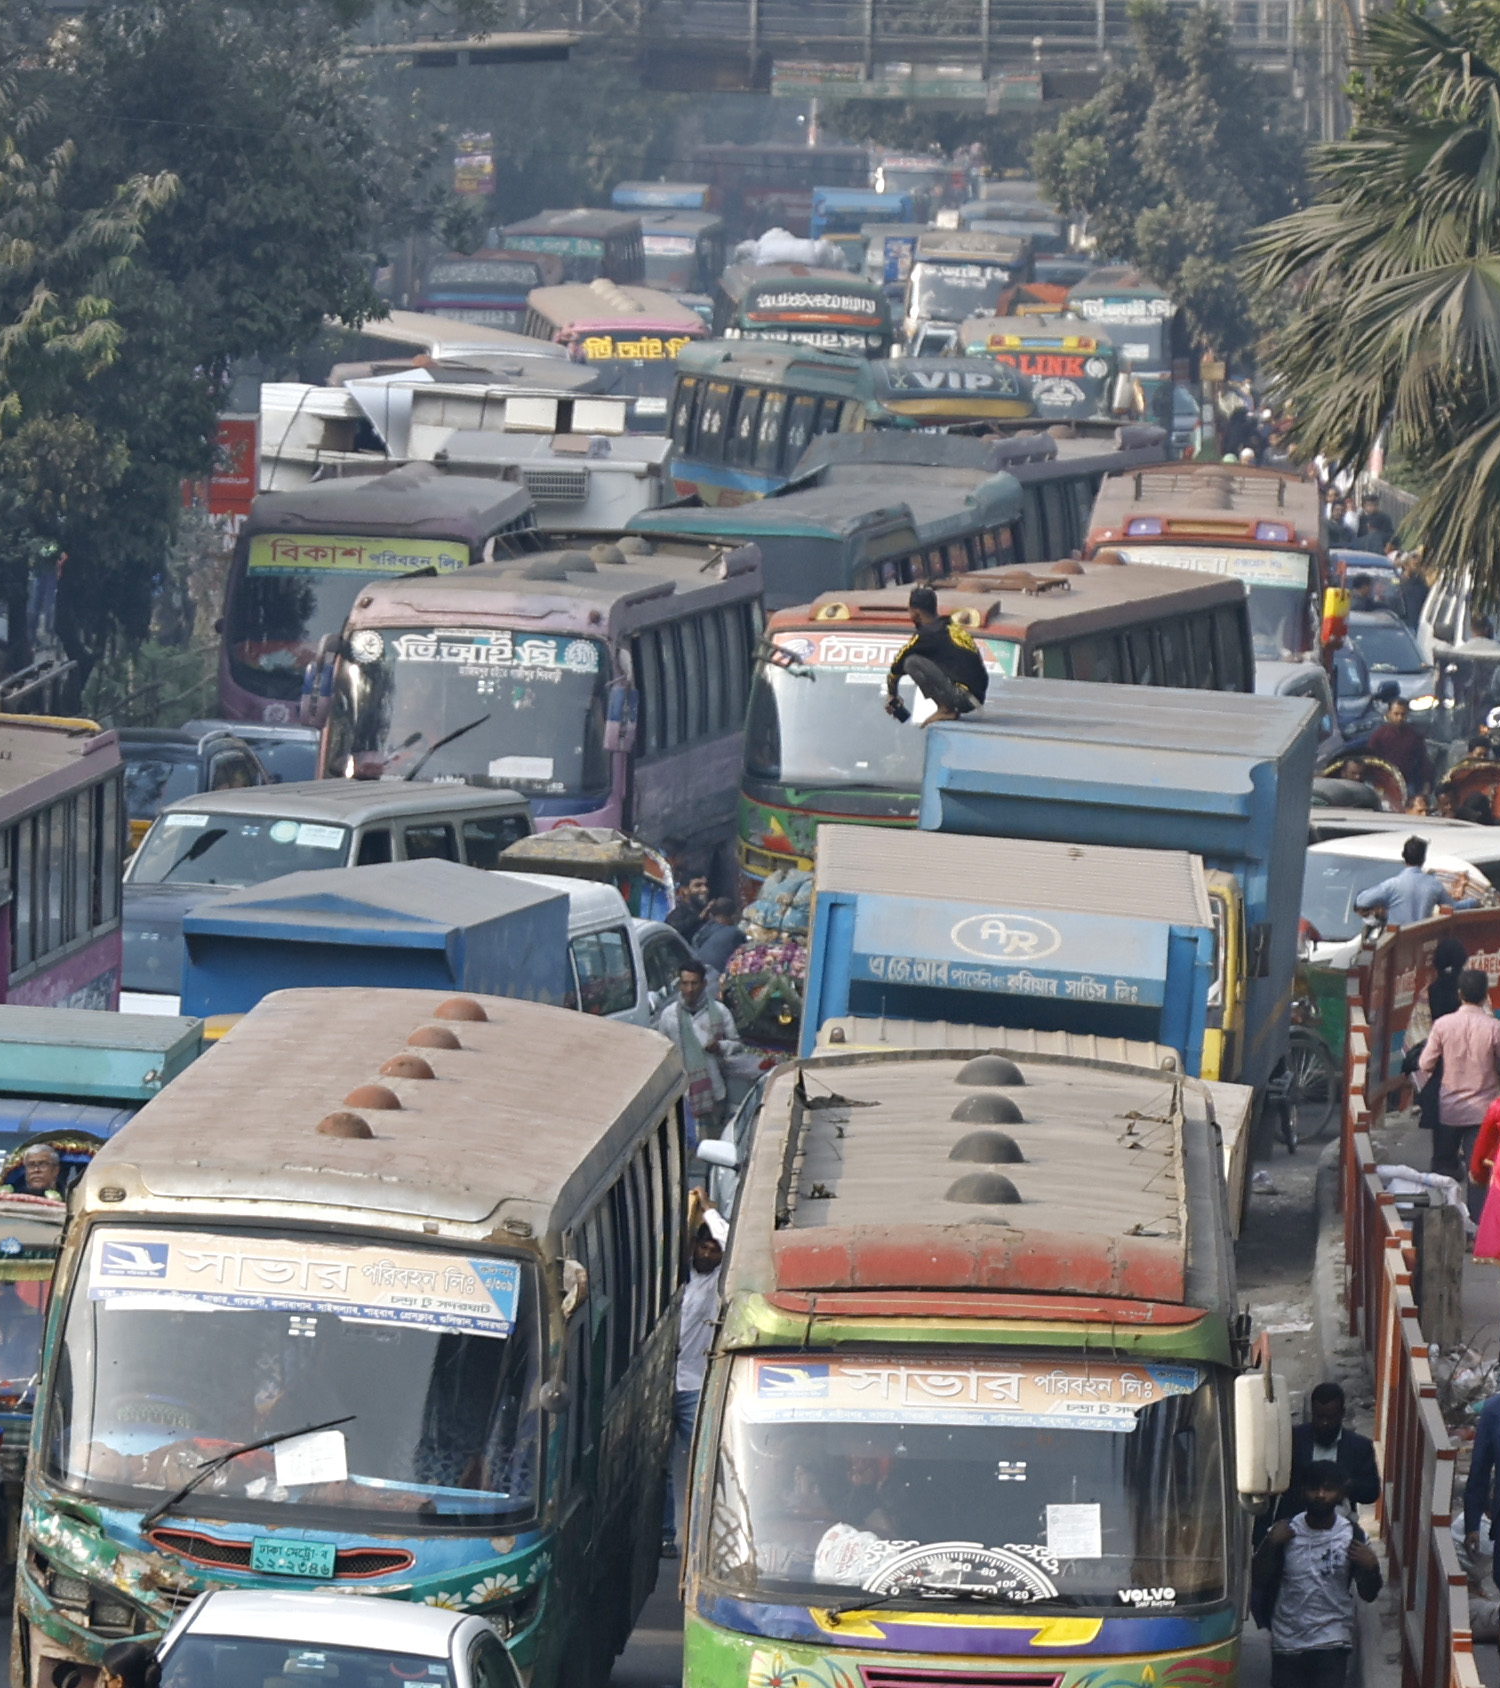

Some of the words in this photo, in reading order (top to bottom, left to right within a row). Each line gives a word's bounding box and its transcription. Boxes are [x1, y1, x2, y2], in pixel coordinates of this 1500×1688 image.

[1020, 355, 1085, 377] LINK
[912, 373, 993, 390] VIP
[271, 538, 366, 563] বিকাশ
[178, 1248, 357, 1297] সাভার
[361, 1259, 439, 1293] পরিবহন
[444, 1266, 477, 1295] লিঃ
[840, 1366, 1026, 1407] সাভার
[1033, 1369, 1113, 1398] পরিবহন
[1119, 1372, 1153, 1399] লিঃ
[1118, 1587, 1176, 1602] VOLVO
